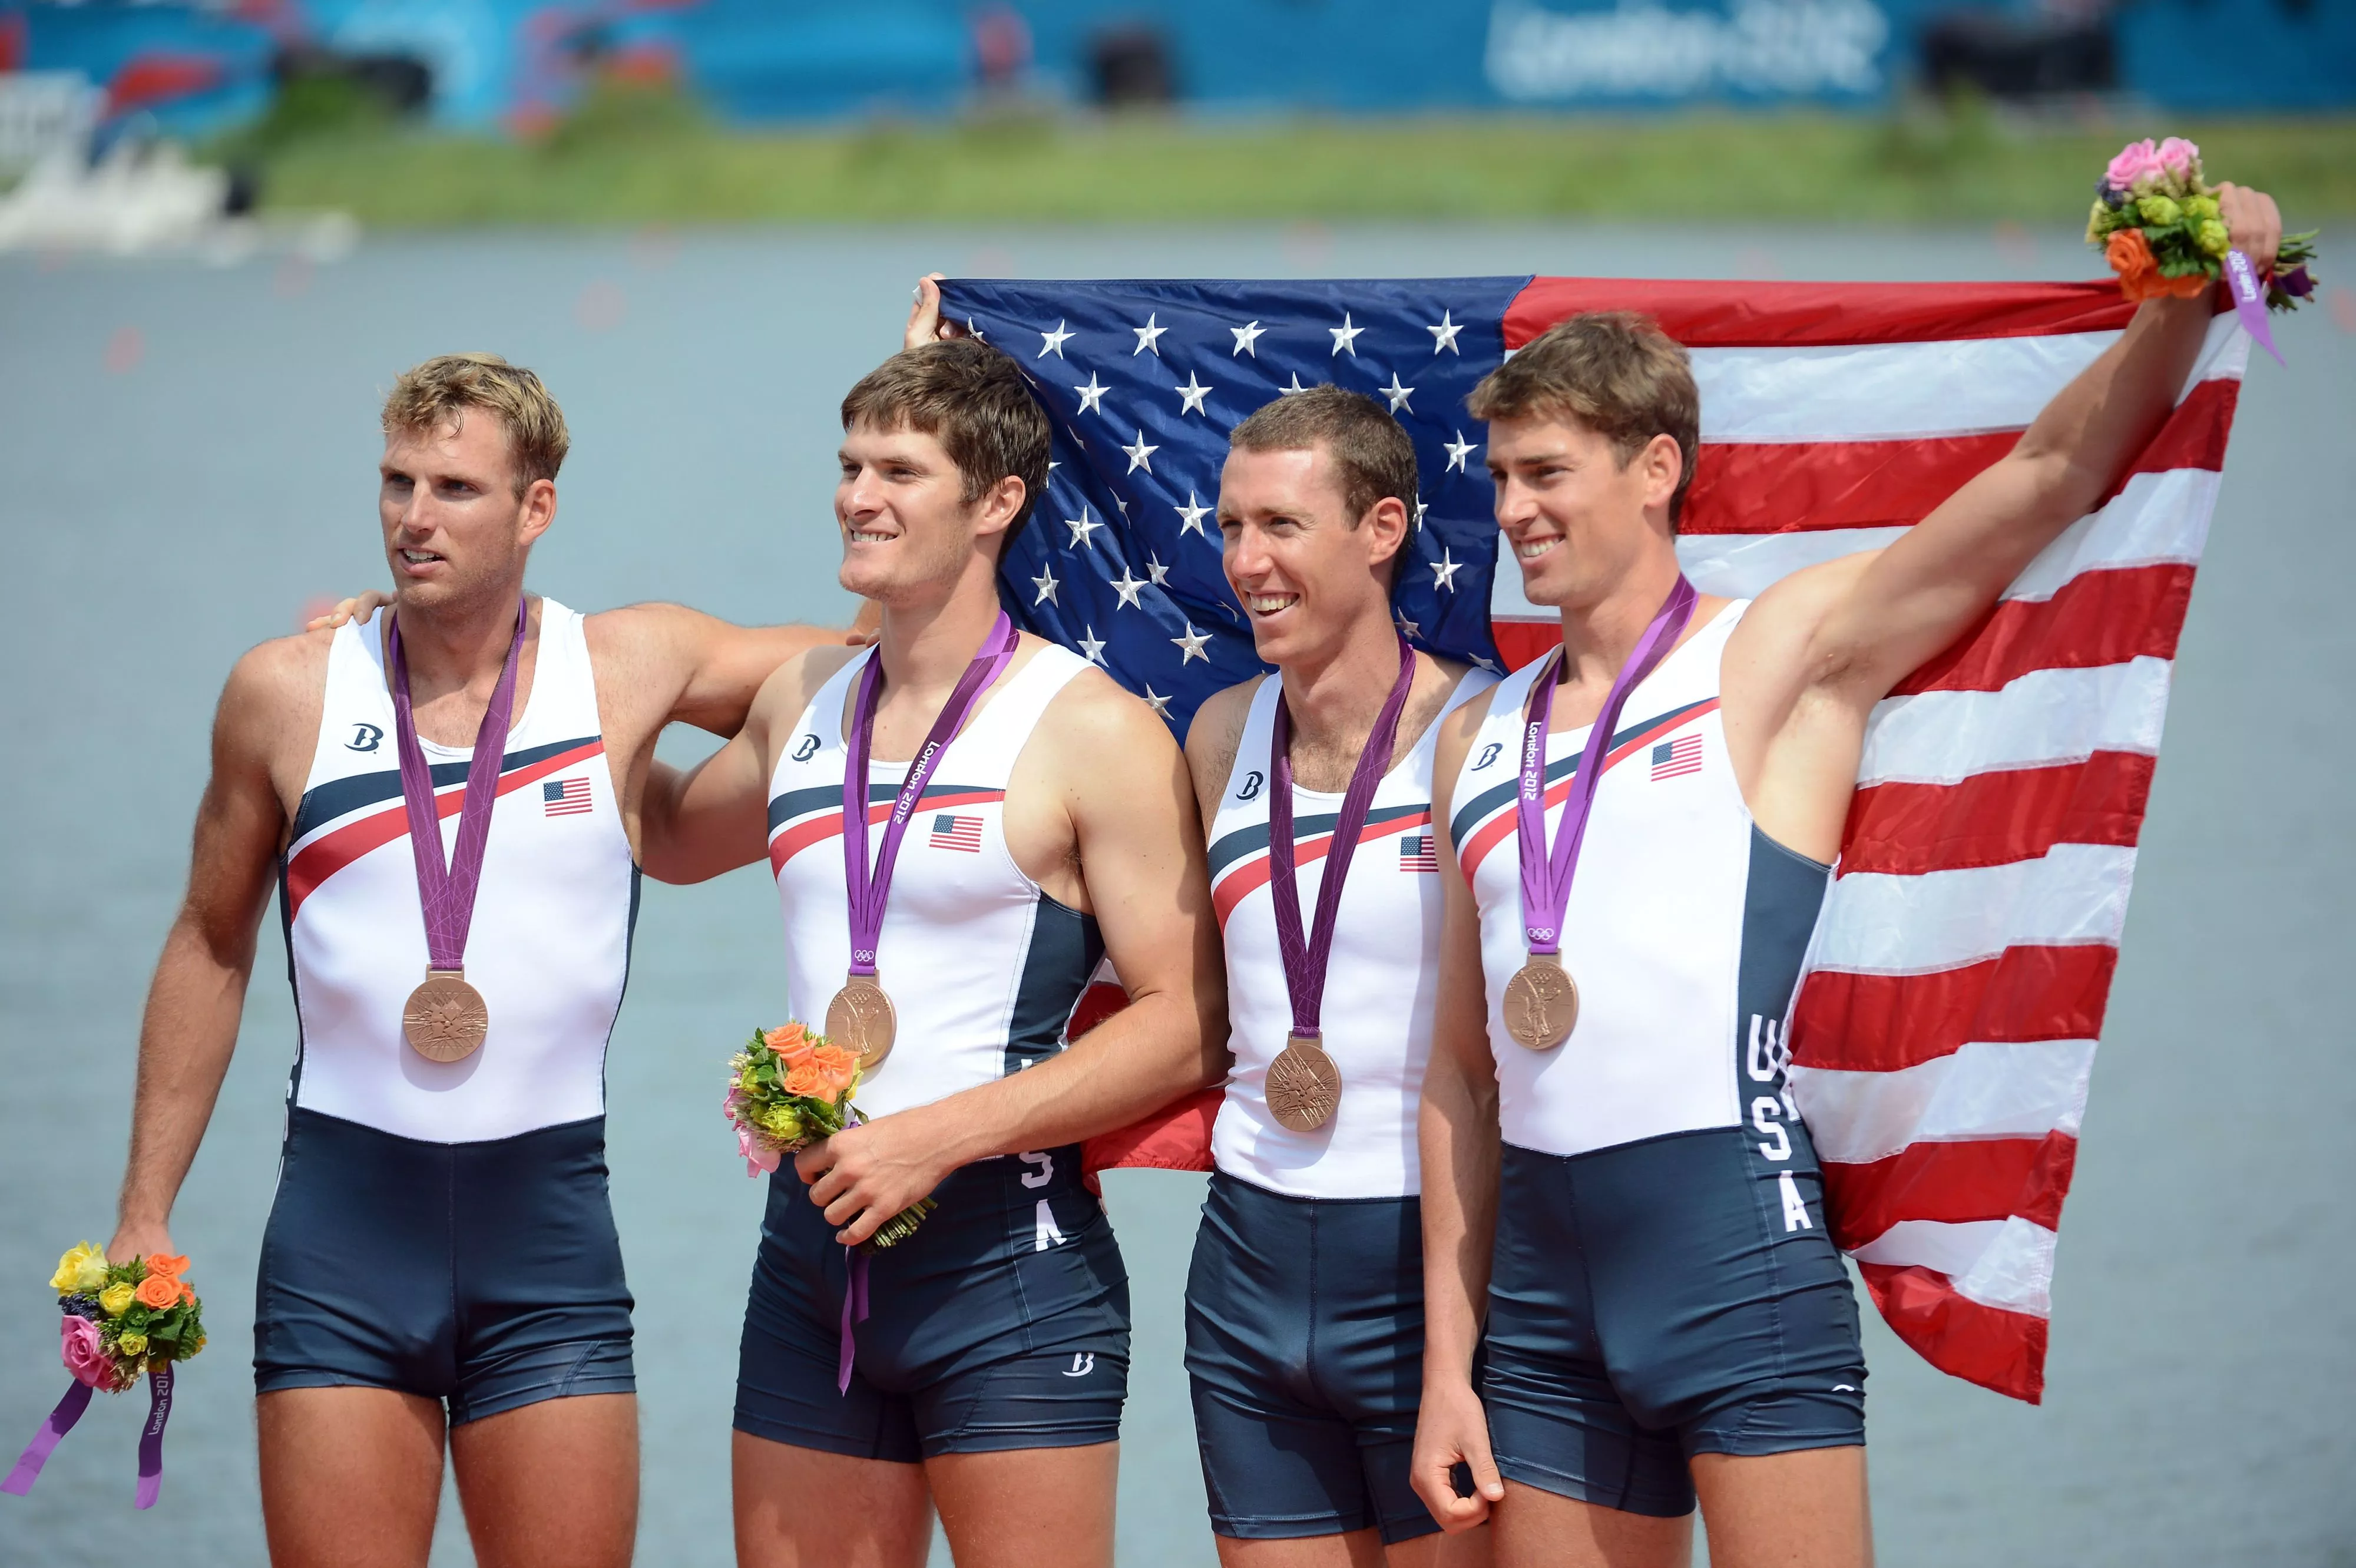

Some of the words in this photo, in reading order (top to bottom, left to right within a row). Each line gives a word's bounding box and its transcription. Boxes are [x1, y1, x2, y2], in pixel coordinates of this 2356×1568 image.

[344, 723, 384, 752] B
[792, 734, 821, 762] B
[1526, 722, 1541, 768] London
[907, 741, 941, 790] London
[1471, 743, 1503, 771] B
[1236, 770, 1263, 800] B
[1524, 770, 1538, 800] 2012
[894, 792, 914, 825] 2012
[1747, 1014, 1813, 1232] USA
[148, 1399, 168, 1435] London
